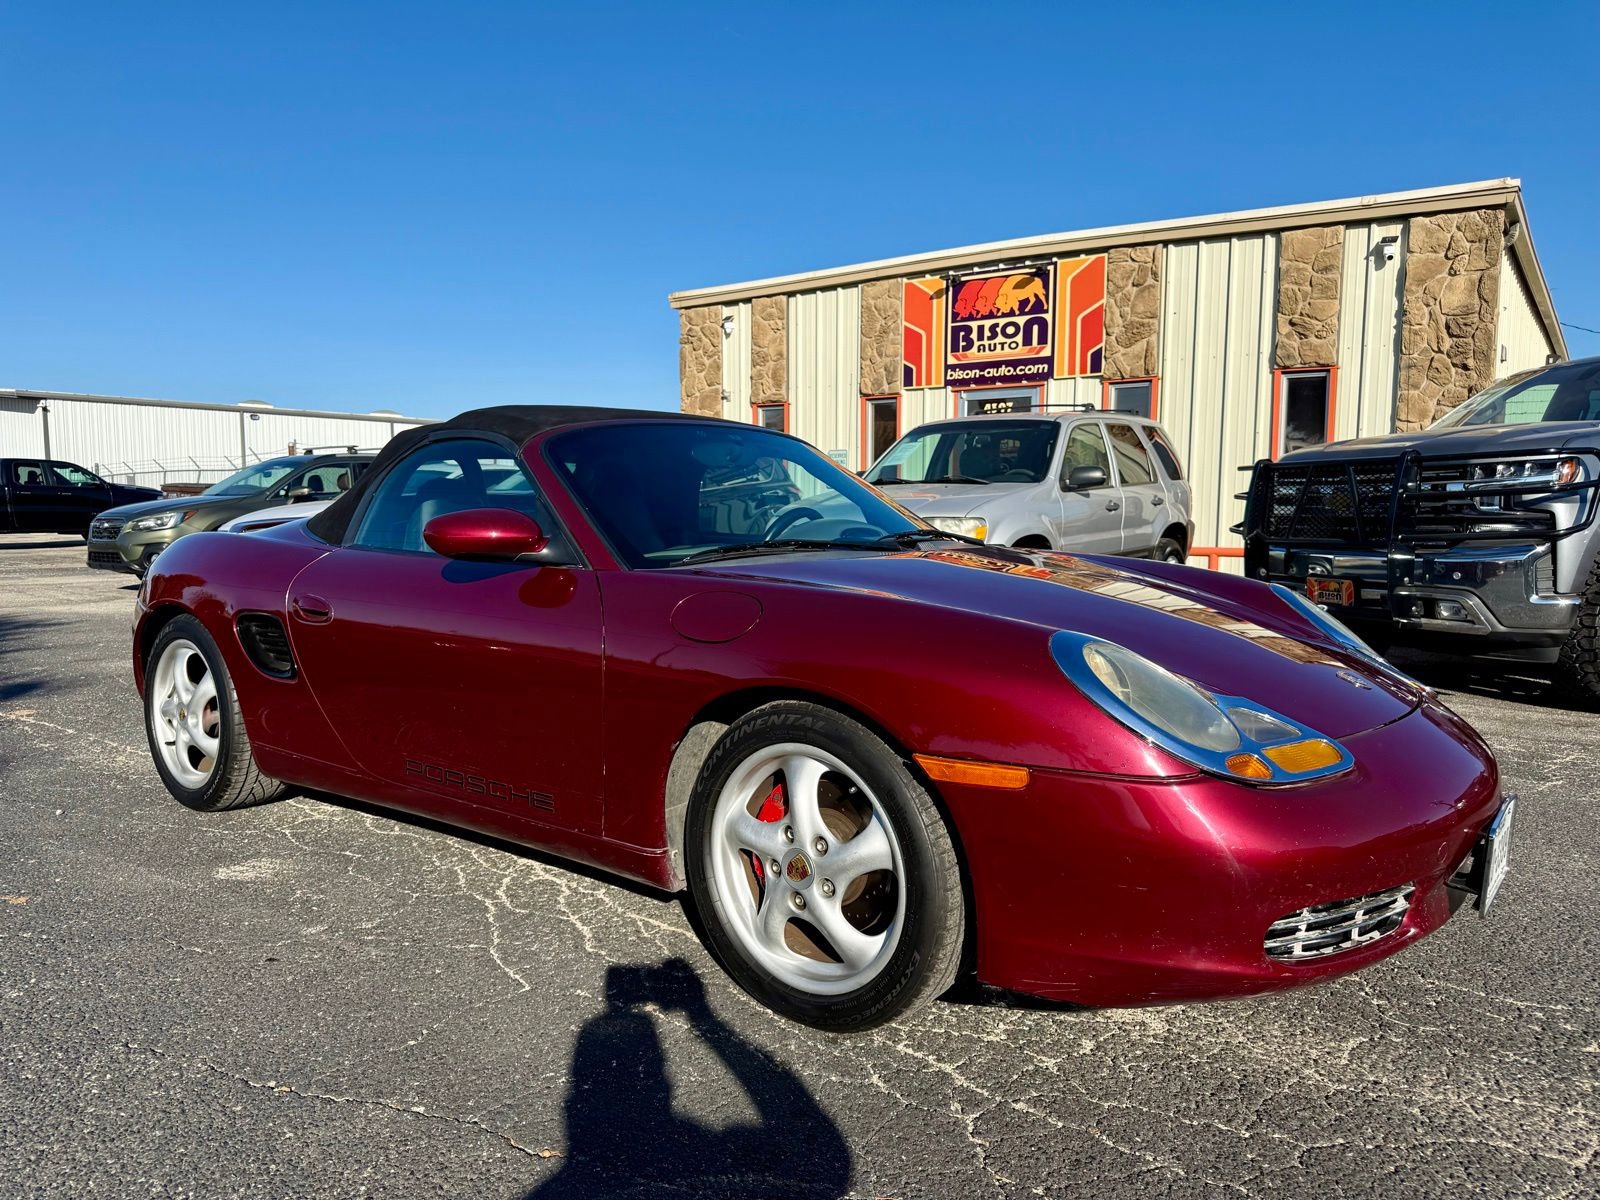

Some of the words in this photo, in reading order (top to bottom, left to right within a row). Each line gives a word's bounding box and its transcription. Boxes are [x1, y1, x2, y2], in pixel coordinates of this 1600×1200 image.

[951, 316, 1048, 353] BISON
[977, 341, 1019, 353] AUTO
[947, 364, 1048, 380] bison-auto.com
[696, 713, 825, 793] CONTINENTAL
[405, 758, 556, 813] PORSCHE
